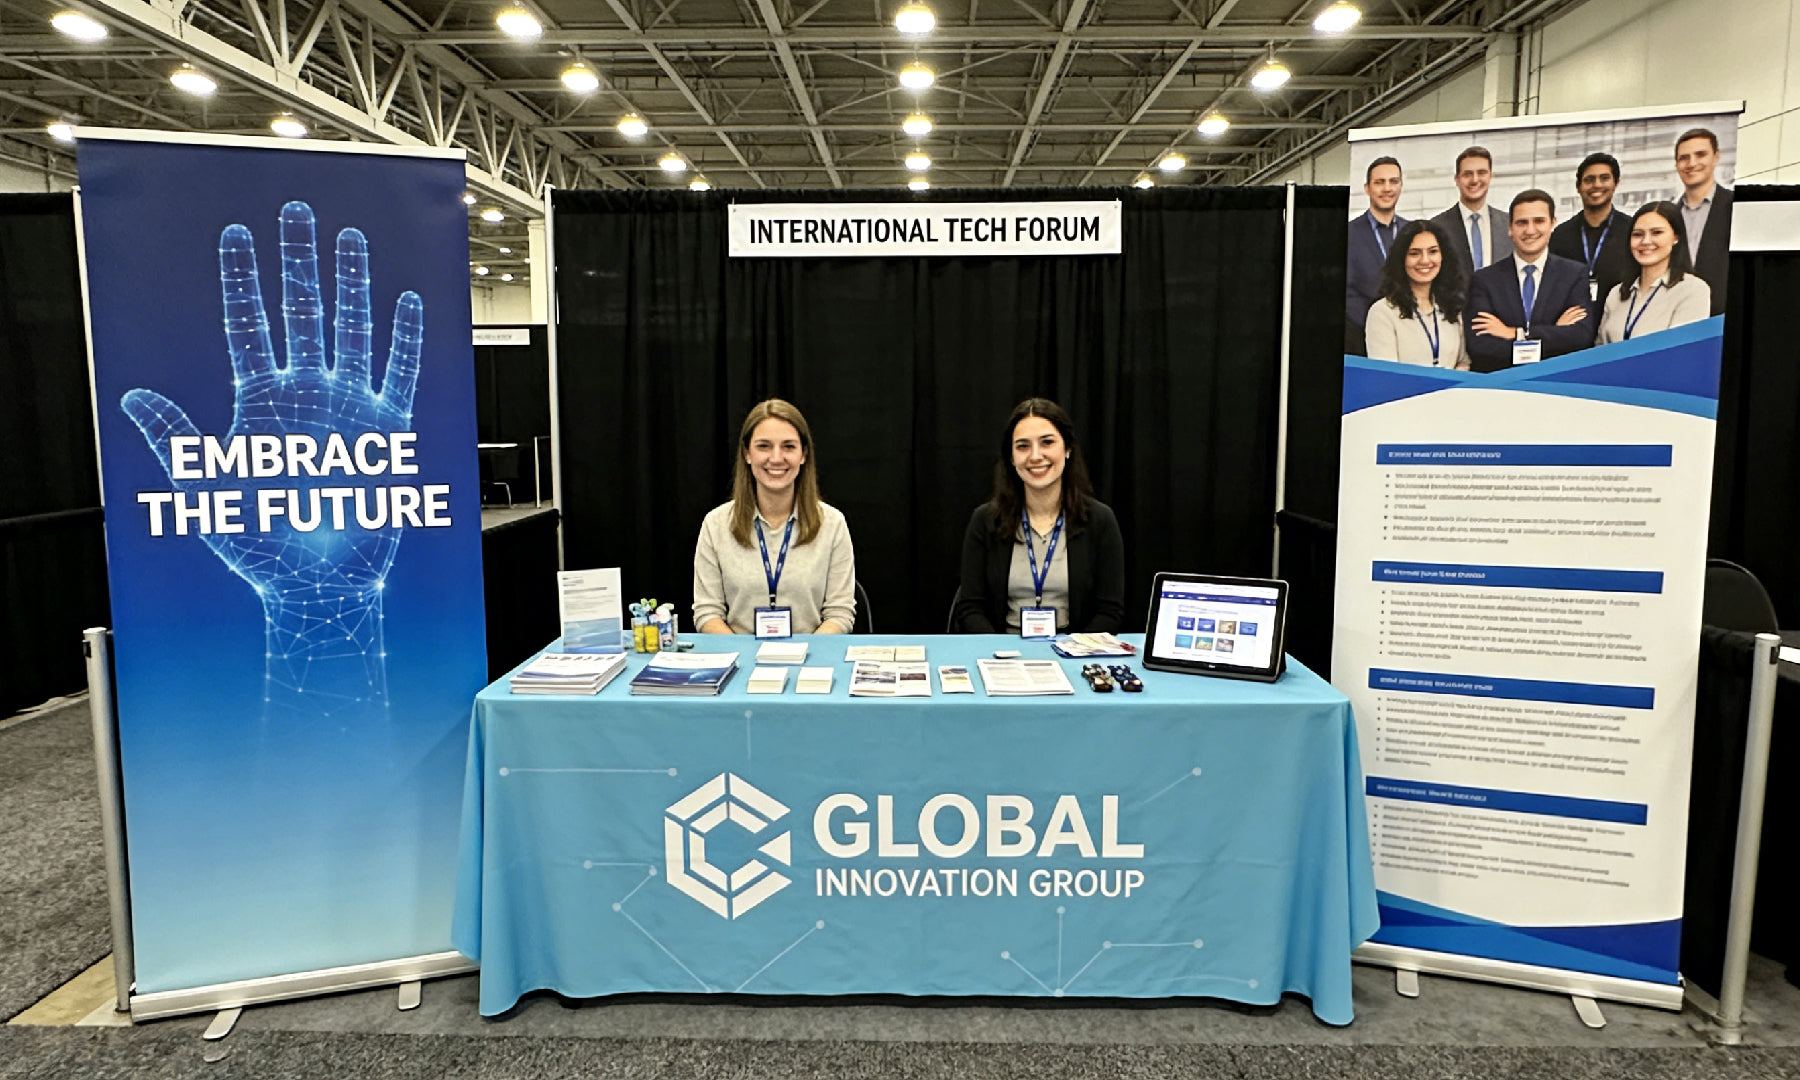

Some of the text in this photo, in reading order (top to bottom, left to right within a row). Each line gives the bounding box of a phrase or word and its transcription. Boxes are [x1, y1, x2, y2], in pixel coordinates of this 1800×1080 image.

[750, 216, 1100, 243] INTERNATIONAL TECH FORUM
[170, 432, 419, 480] EMBRACE
[137, 484, 452, 536] THE FUTURE
[813, 793, 1145, 859] GLOBAL
[815, 868, 1145, 898] INNOVATION GROUP
